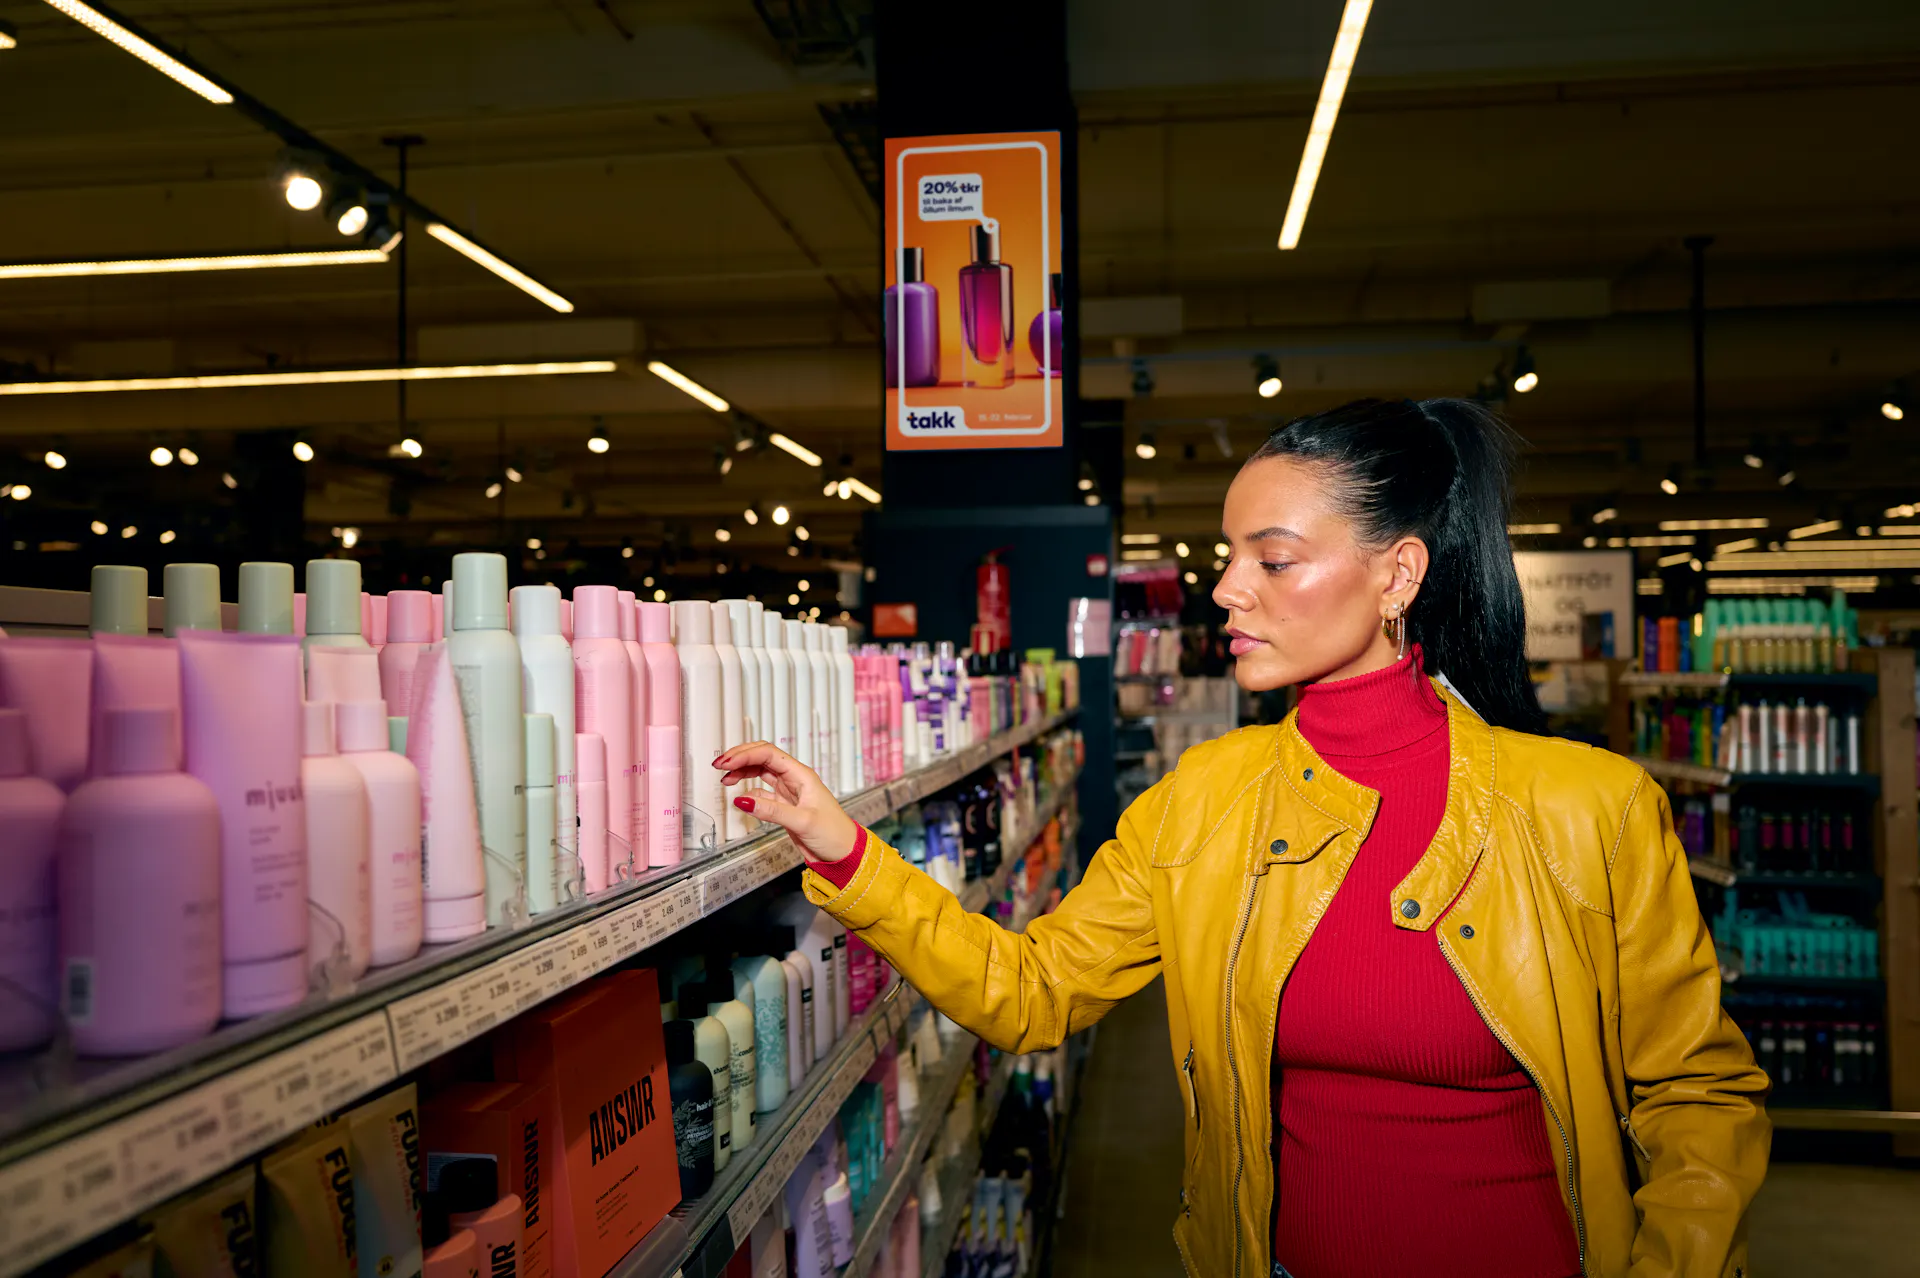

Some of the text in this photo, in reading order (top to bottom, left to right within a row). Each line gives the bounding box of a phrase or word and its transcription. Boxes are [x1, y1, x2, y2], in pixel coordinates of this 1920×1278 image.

[924, 181, 958, 194] 20%
[907, 411, 955, 429] takk
[590, 1076, 656, 1168] ANSWR
[325, 1147, 356, 1259] FUDGE
[524, 1118, 540, 1230] ANSWR
